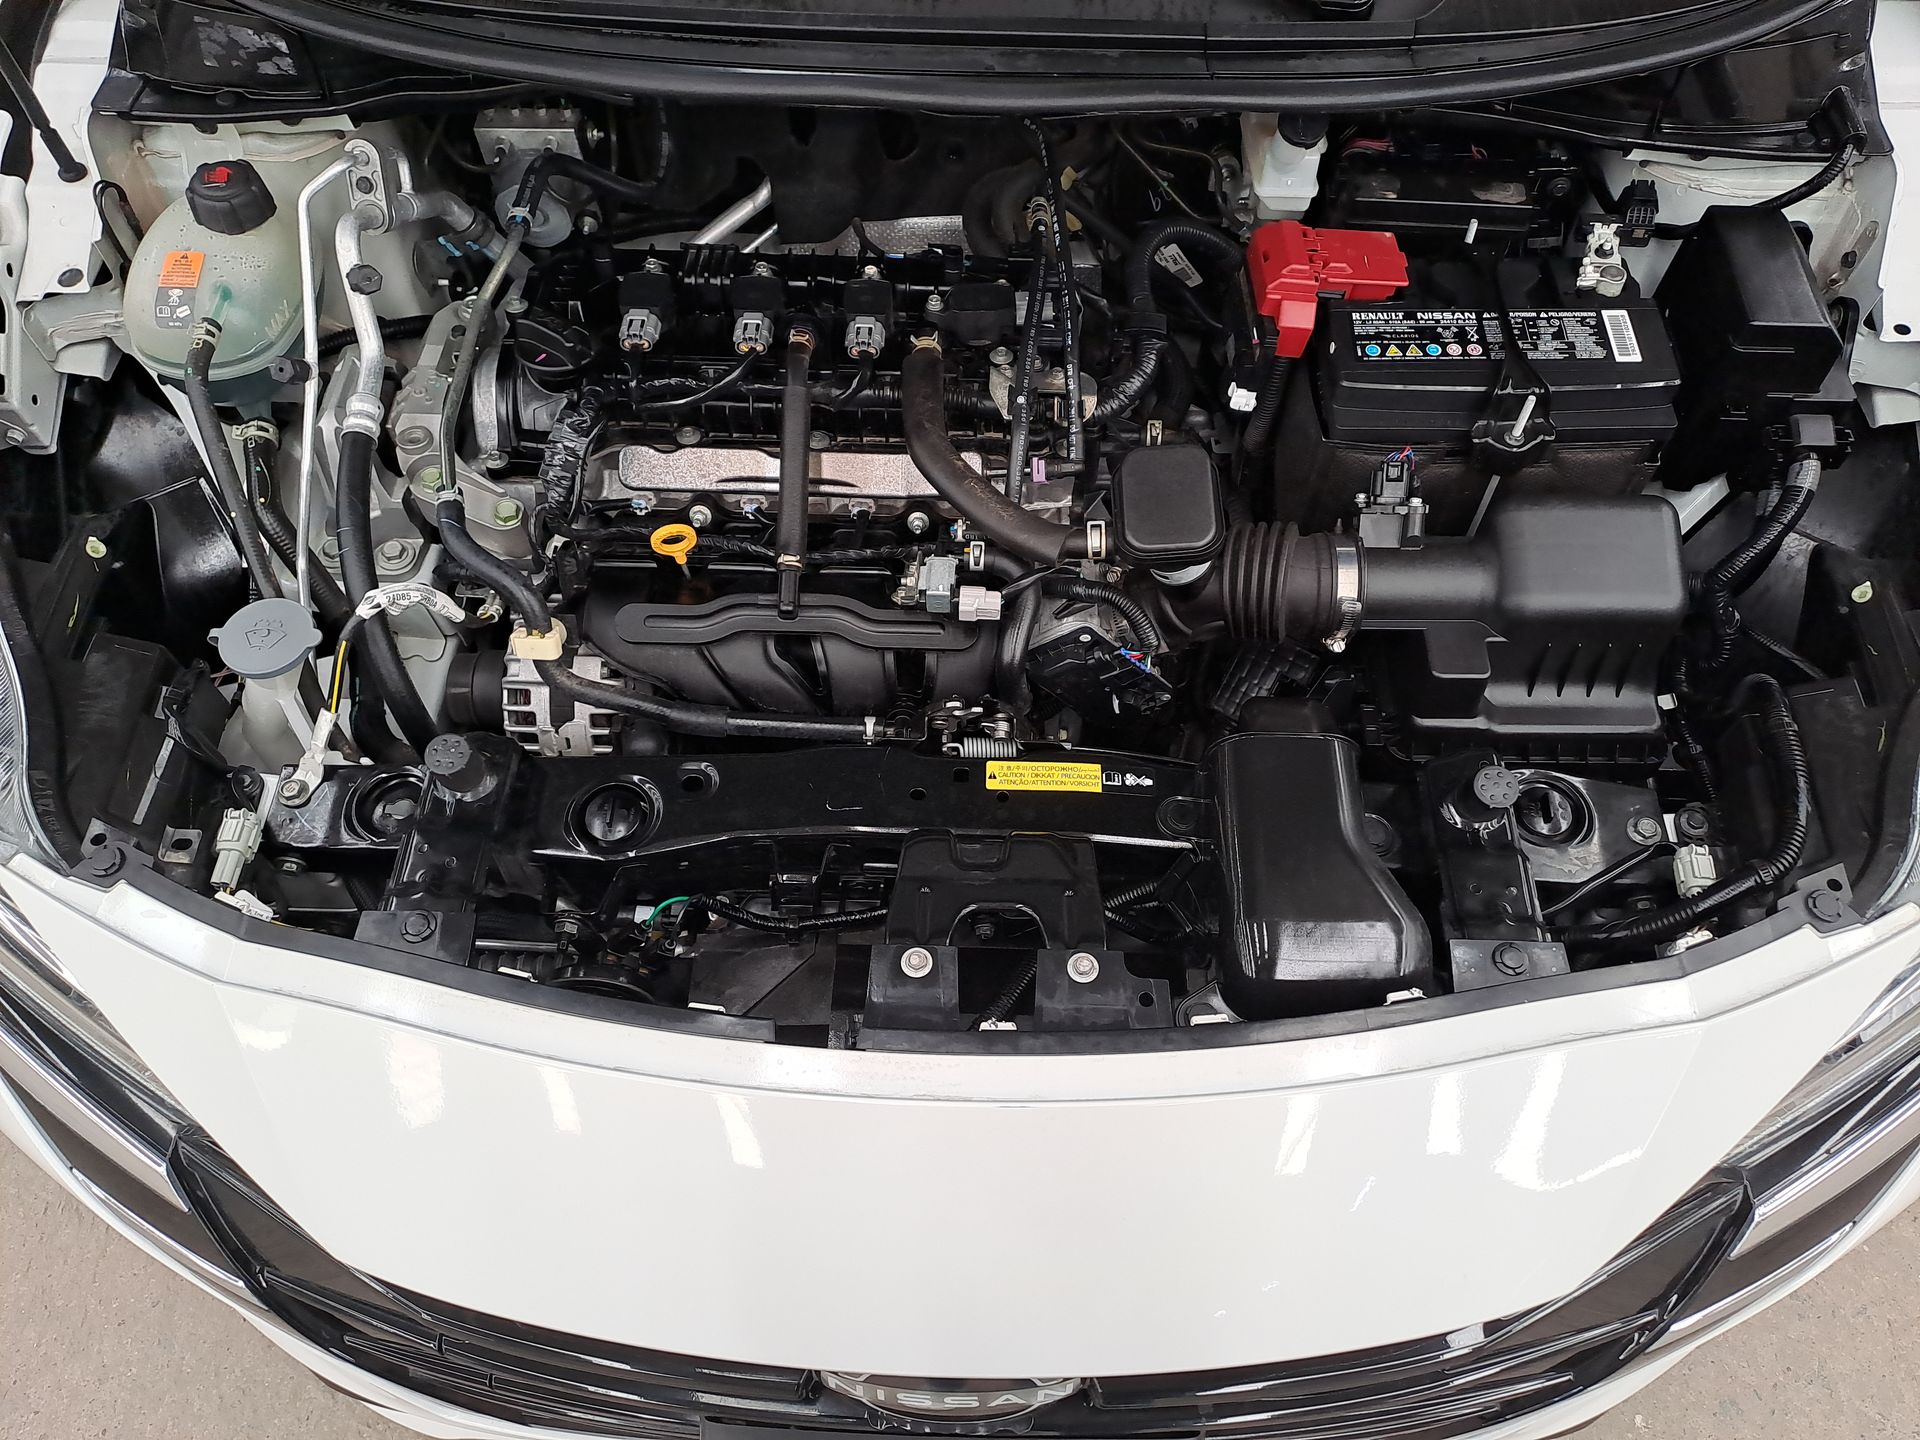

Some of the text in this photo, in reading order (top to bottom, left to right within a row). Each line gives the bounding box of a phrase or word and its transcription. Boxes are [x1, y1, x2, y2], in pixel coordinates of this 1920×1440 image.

[1352, 312, 1404, 320] RENAULT
[1417, 312, 1476, 320] NISSAN
[998, 771, 1025, 779] CAUTION
[828, 1376, 1074, 1408] NISSAN
